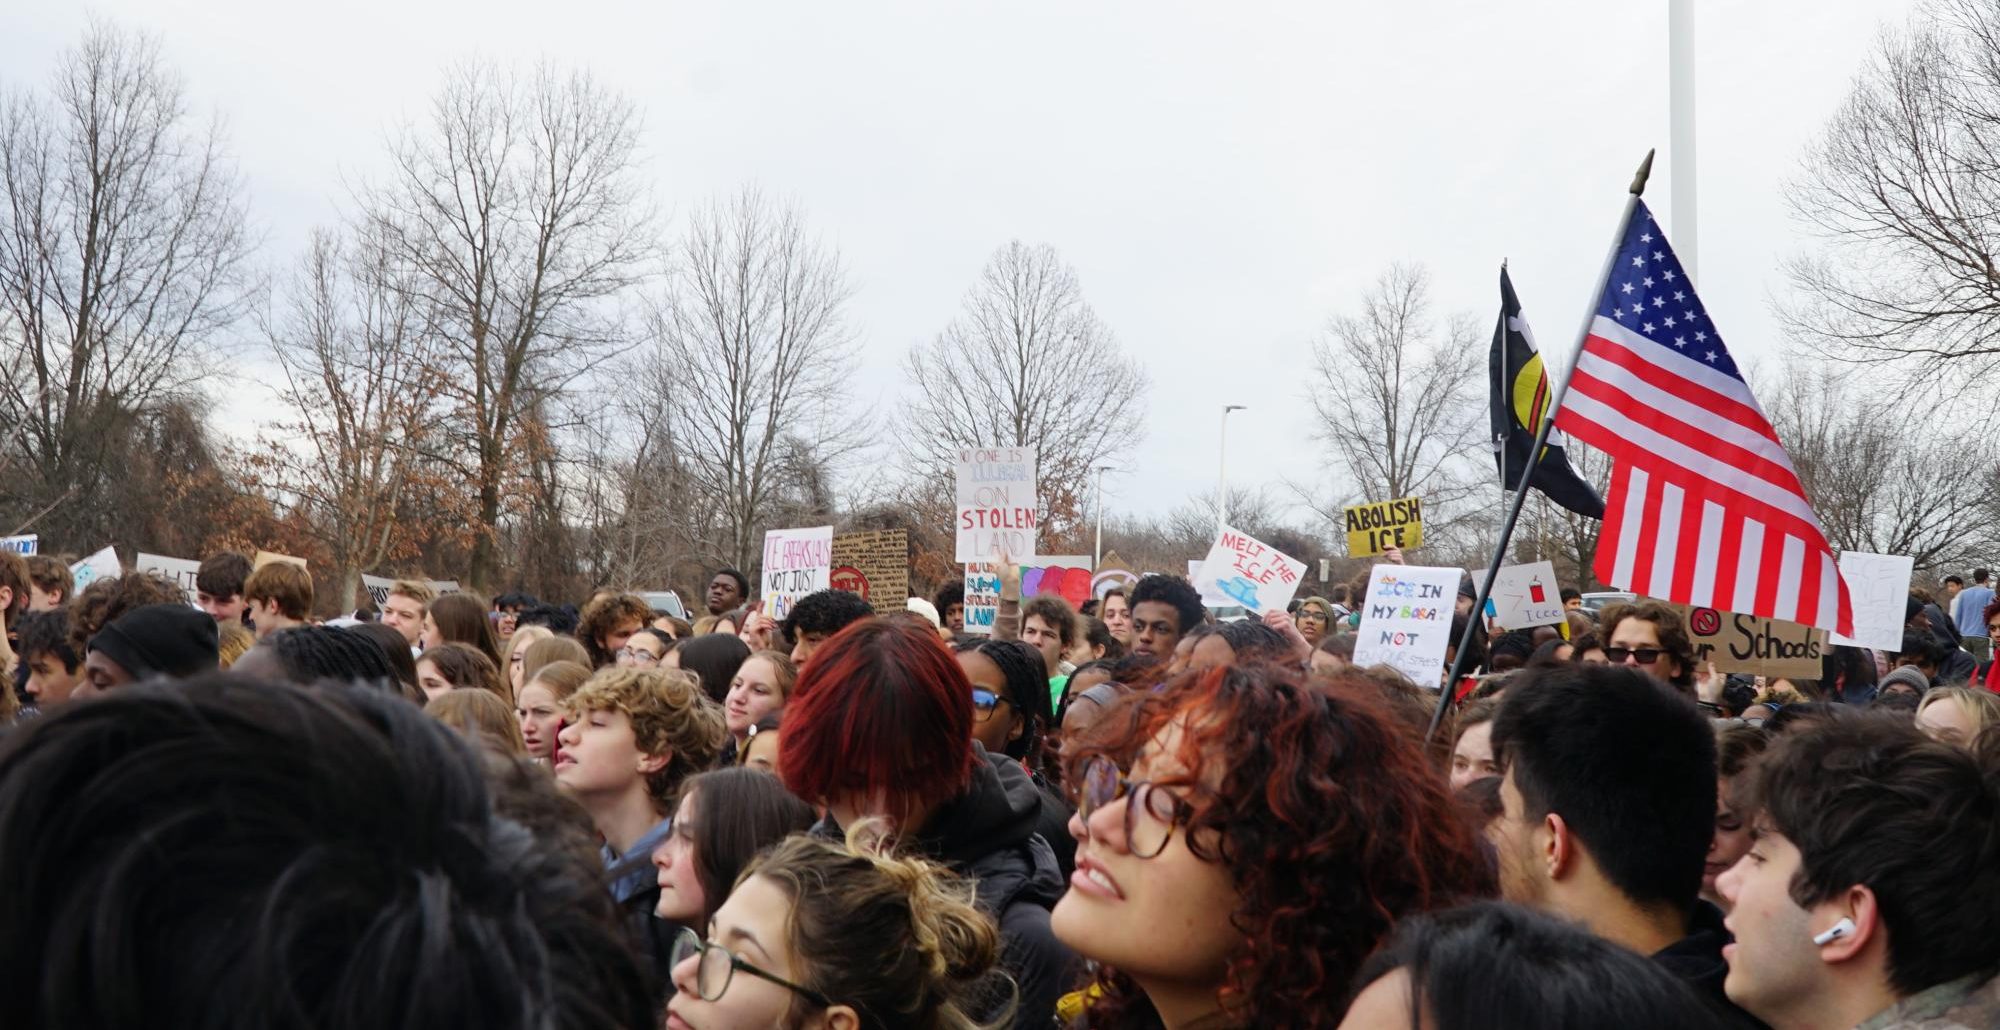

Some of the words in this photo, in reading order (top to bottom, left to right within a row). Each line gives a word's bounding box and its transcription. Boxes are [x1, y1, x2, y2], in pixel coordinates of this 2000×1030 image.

[975, 450, 1000, 465] ONE
[1007, 450, 1023, 463] IS
[975, 486, 1009, 507] ON
[962, 508, 1036, 530] STOLEN
[1346, 497, 1422, 532] ABOLISH
[974, 531, 1025, 557] LAND
[1369, 527, 1406, 553] ICE
[1220, 532, 1265, 558] MELT
[1271, 553, 1297, 584] THE
[1232, 553, 1275, 584] ICE
[767, 571, 789, 592] NOT
[789, 568, 817, 593] JUST
[1376, 578, 1416, 598] ICE
[1418, 584, 1442, 598] IN
[1372, 604, 1397, 619] MY
[1380, 631, 1419, 646] NOT
[1729, 613, 1820, 660] Schools
